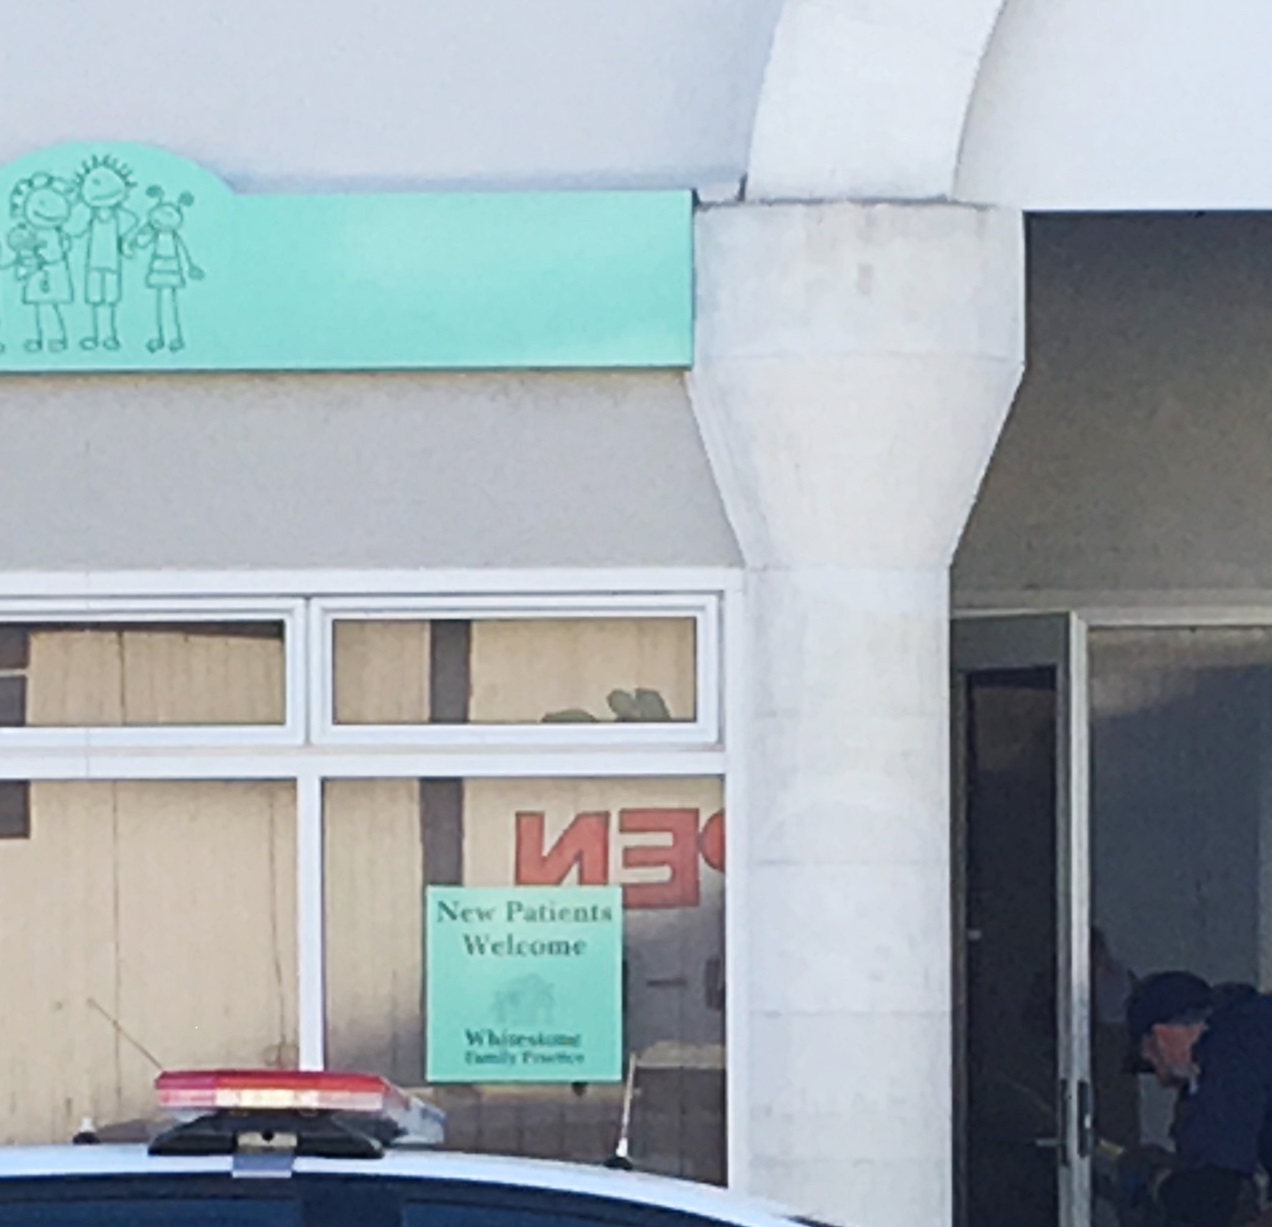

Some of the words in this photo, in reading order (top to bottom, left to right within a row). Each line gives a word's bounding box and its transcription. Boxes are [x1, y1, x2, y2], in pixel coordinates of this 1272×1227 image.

[437, 900, 495, 923] New
[506, 899, 613, 923] Patients
[463, 933, 586, 957] Welcome
